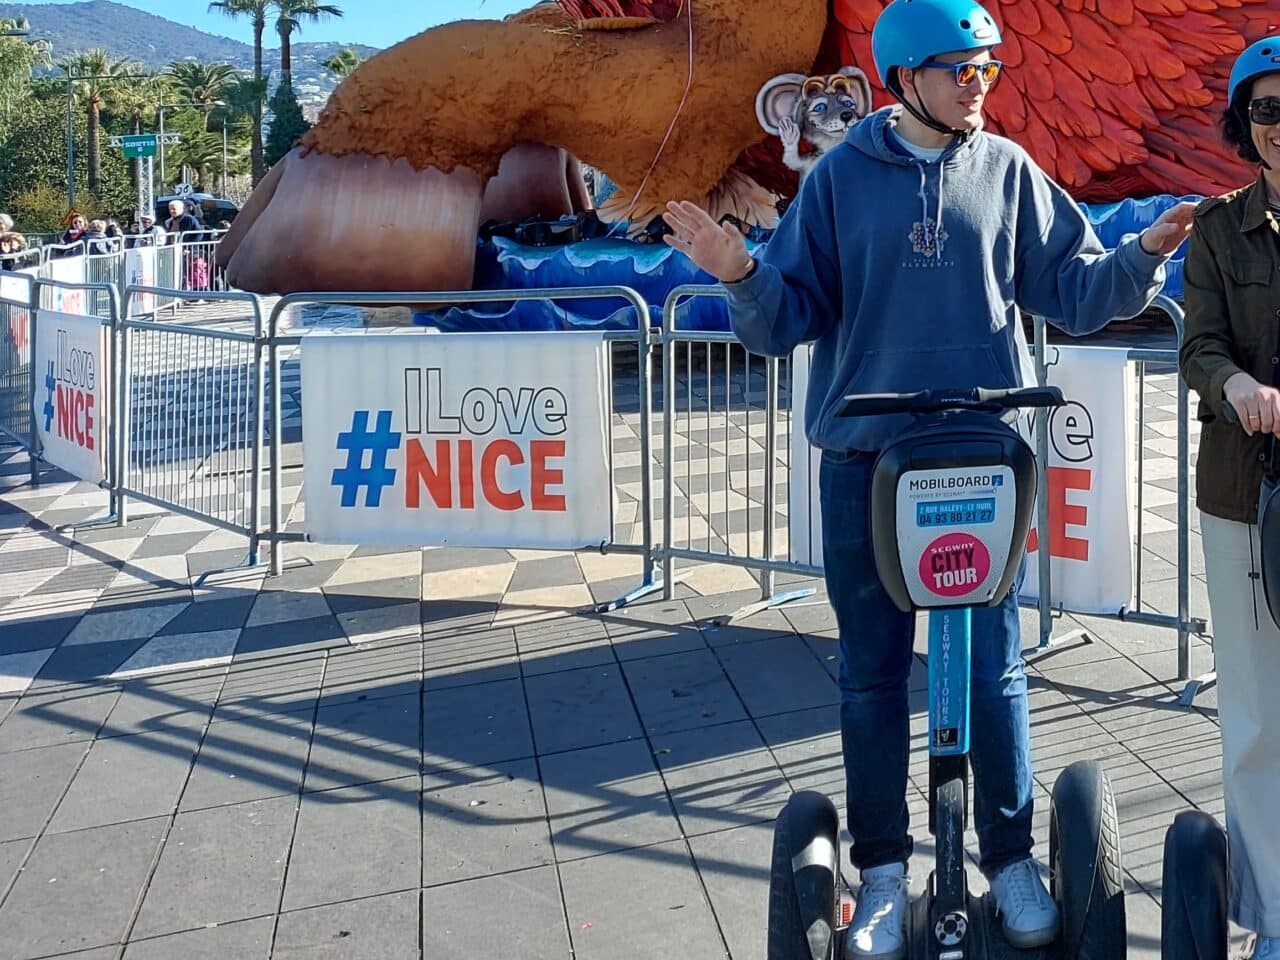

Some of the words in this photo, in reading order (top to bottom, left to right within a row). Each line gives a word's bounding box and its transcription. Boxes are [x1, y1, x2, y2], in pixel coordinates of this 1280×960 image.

[909, 475, 990, 491] MOBILBOARD
[920, 515, 932, 524] 04
[935, 513, 947, 523] 93
[950, 512, 962, 522] 80
[966, 511, 976, 521] 21
[980, 510, 992, 520] 27
[931, 542, 974, 553] SEGWAY
[931, 548, 974, 573] CITY
[933, 567, 978, 589] TOUR
